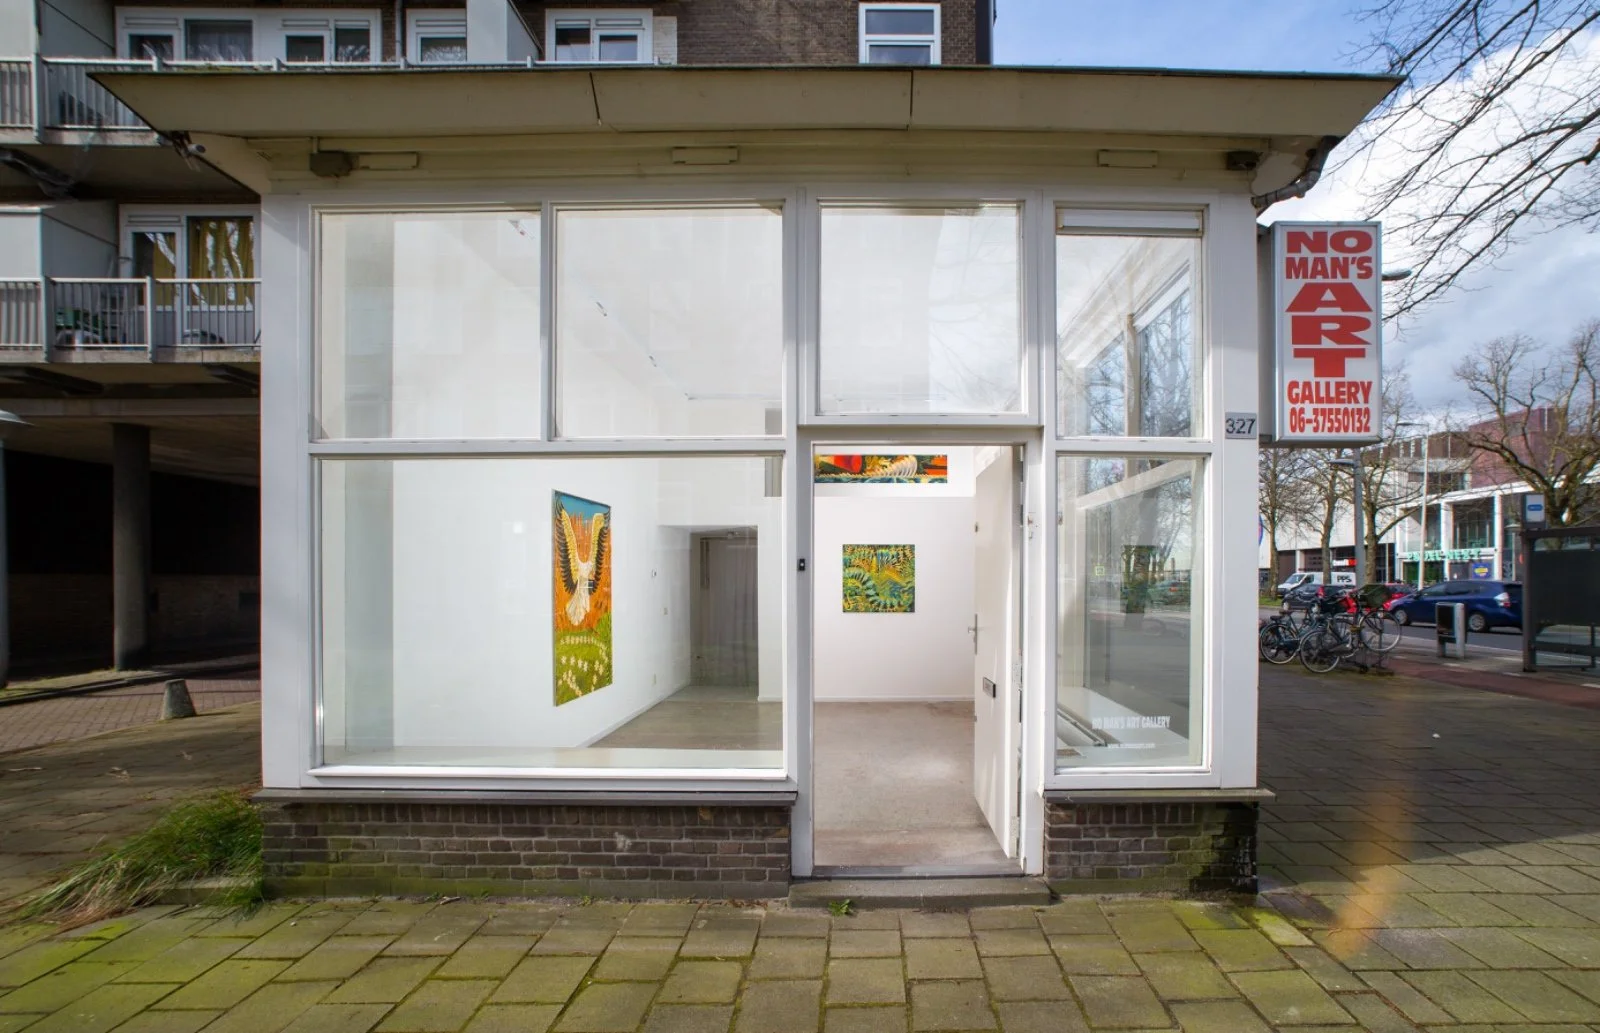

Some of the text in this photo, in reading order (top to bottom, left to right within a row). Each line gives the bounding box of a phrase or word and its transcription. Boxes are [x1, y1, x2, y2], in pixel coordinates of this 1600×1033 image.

[1286, 230, 1373, 254] NO
[1285, 256, 1373, 280] MAN'S
[1285, 282, 1373, 378] ART
[1287, 380, 1373, 405] GALLERY
[1225, 417, 1256, 434] 327
[1289, 406, 1371, 433] 06-37550132
[1141, 715, 1171, 729] GALLERY
